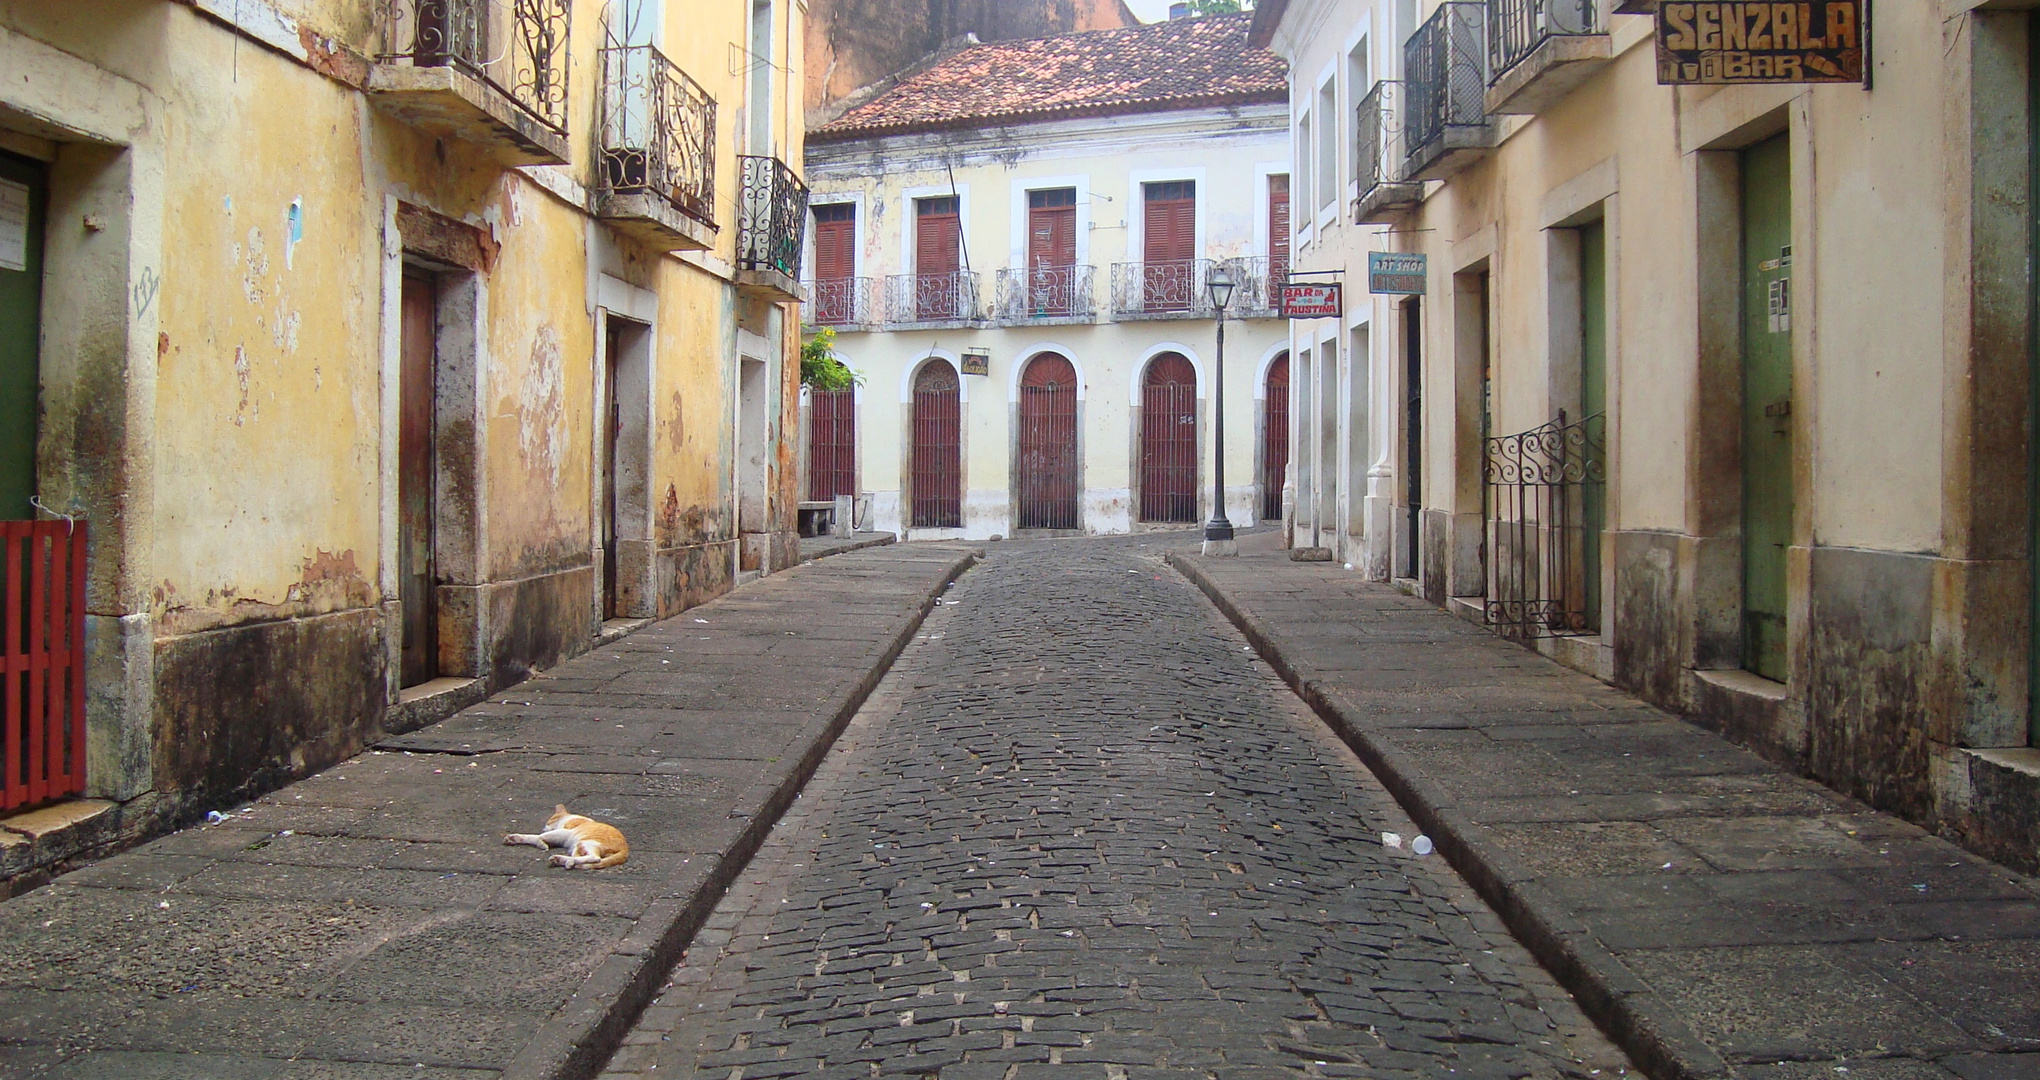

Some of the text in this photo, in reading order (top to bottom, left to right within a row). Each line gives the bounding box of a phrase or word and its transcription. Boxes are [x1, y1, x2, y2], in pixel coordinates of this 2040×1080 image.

[1665, 2, 1856, 50] SENZALA
[1722, 51, 1803, 80] BAR
[1373, 260, 1424, 272] ART SHOP
[1284, 288, 1313, 297] BAR
[1284, 298, 1336, 314] FAUSTINA
